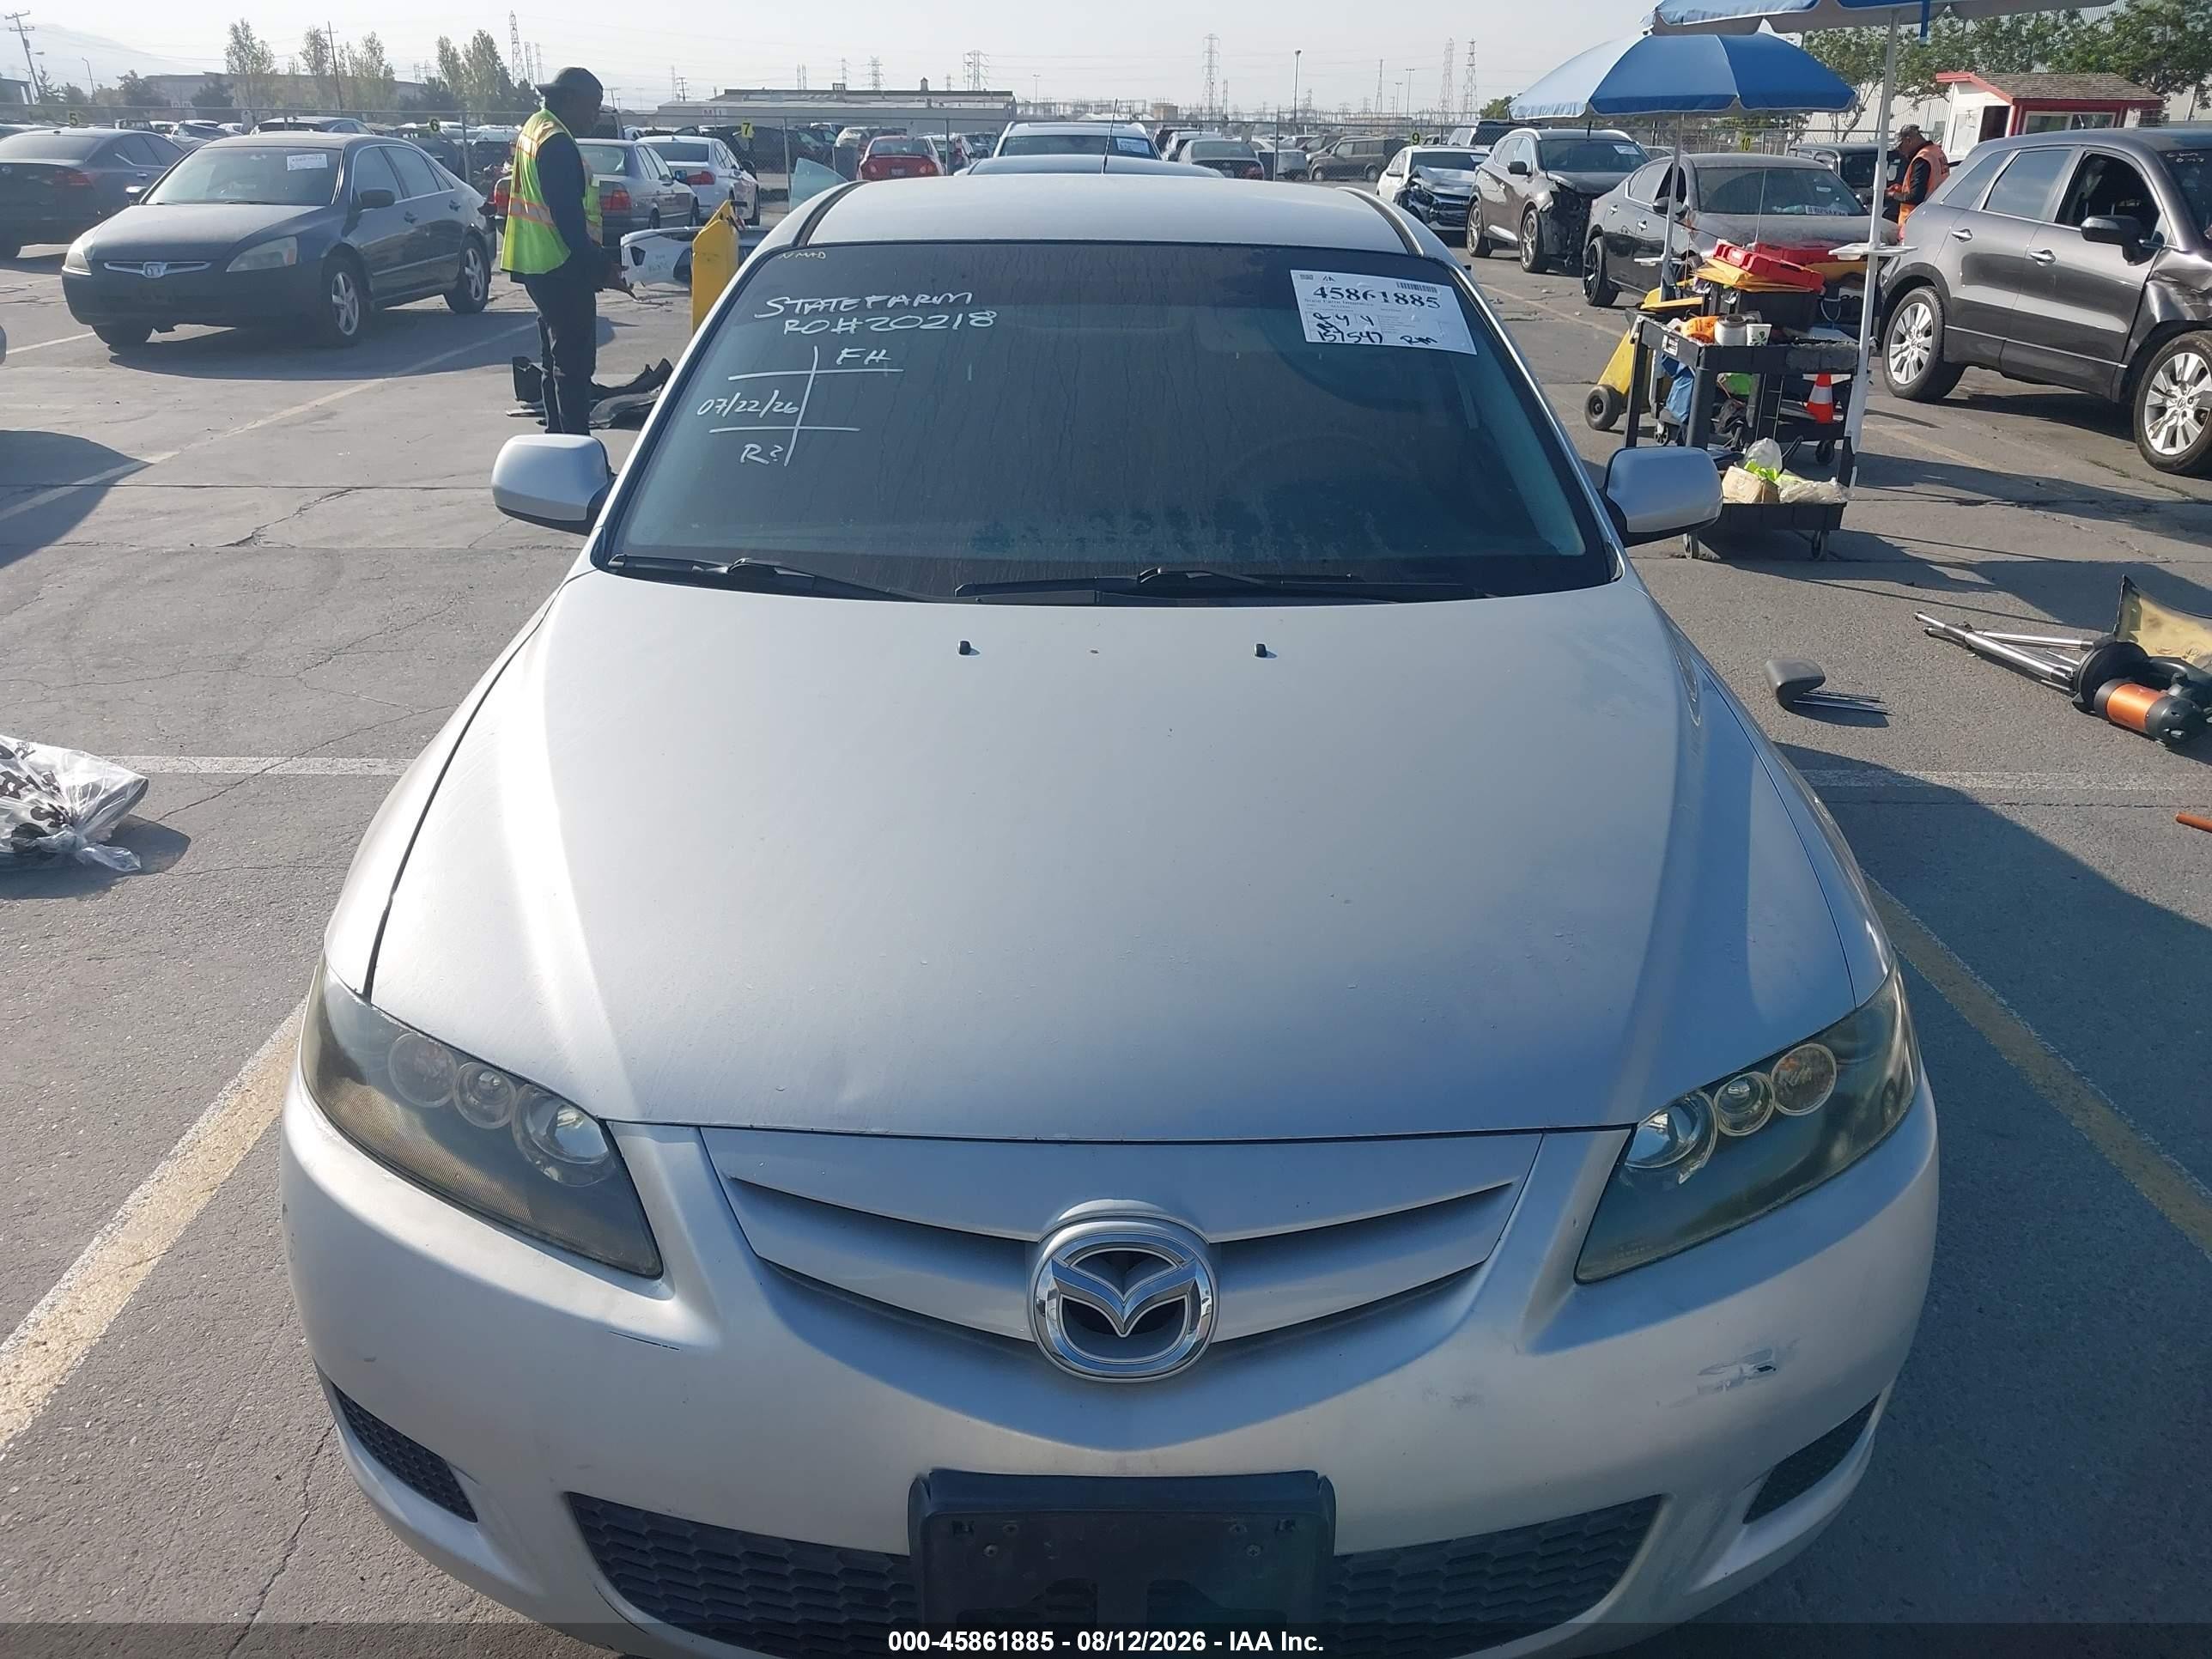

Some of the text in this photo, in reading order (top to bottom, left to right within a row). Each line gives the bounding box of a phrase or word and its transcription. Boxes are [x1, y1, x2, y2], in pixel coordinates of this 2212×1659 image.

[70, 112, 78, 126] 5
[430, 118, 439, 131] 6
[742, 122, 750, 135] 7
[1412, 132, 1420, 145] 9
[1741, 137, 1751, 150] 10
[1313, 286, 1441, 309] 45861885
[754, 292, 972, 319] STATE FARM
[836, 347, 892, 365] FH
[696, 389, 799, 418] 07/22/26
